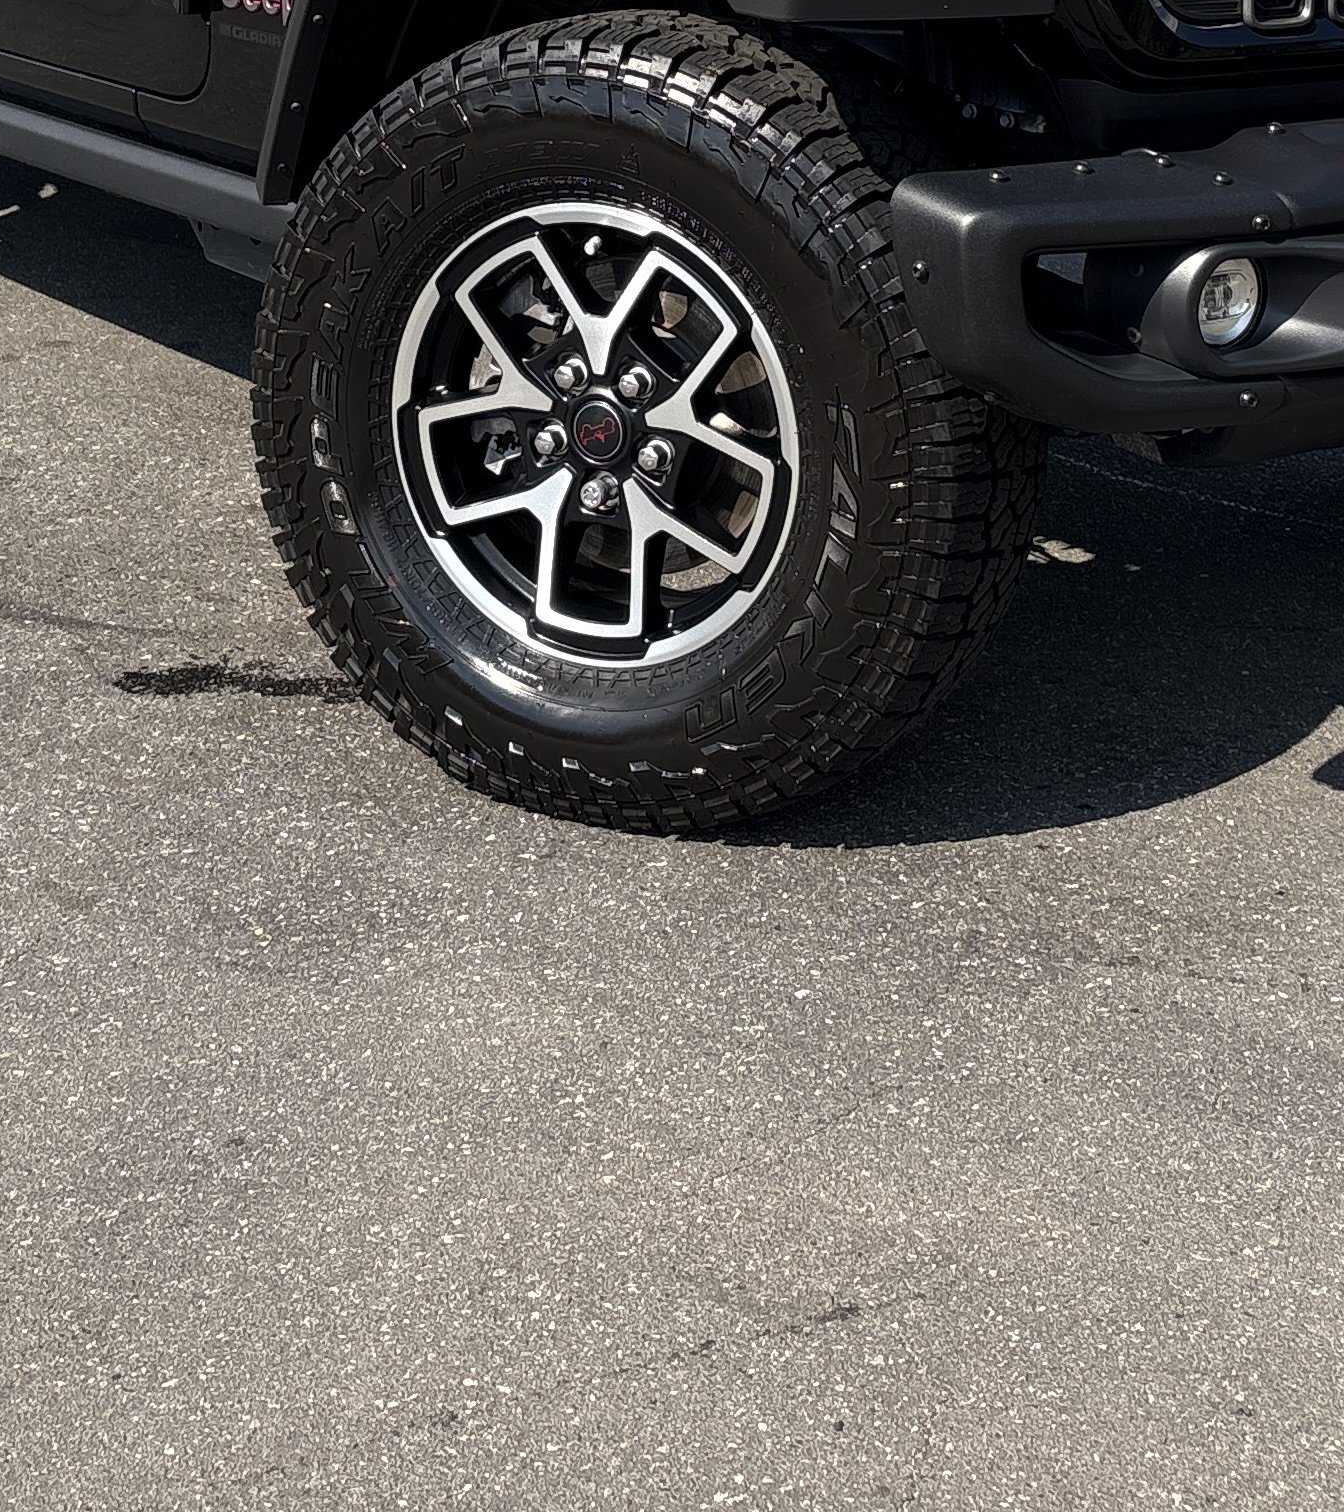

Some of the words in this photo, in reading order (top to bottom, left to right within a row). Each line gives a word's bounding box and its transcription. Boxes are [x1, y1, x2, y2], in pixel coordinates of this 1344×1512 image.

[232, 26, 283, 47] GLADIA
[310, 242, 453, 675] WILDPEAK
[685, 388, 862, 743] FALKEN
